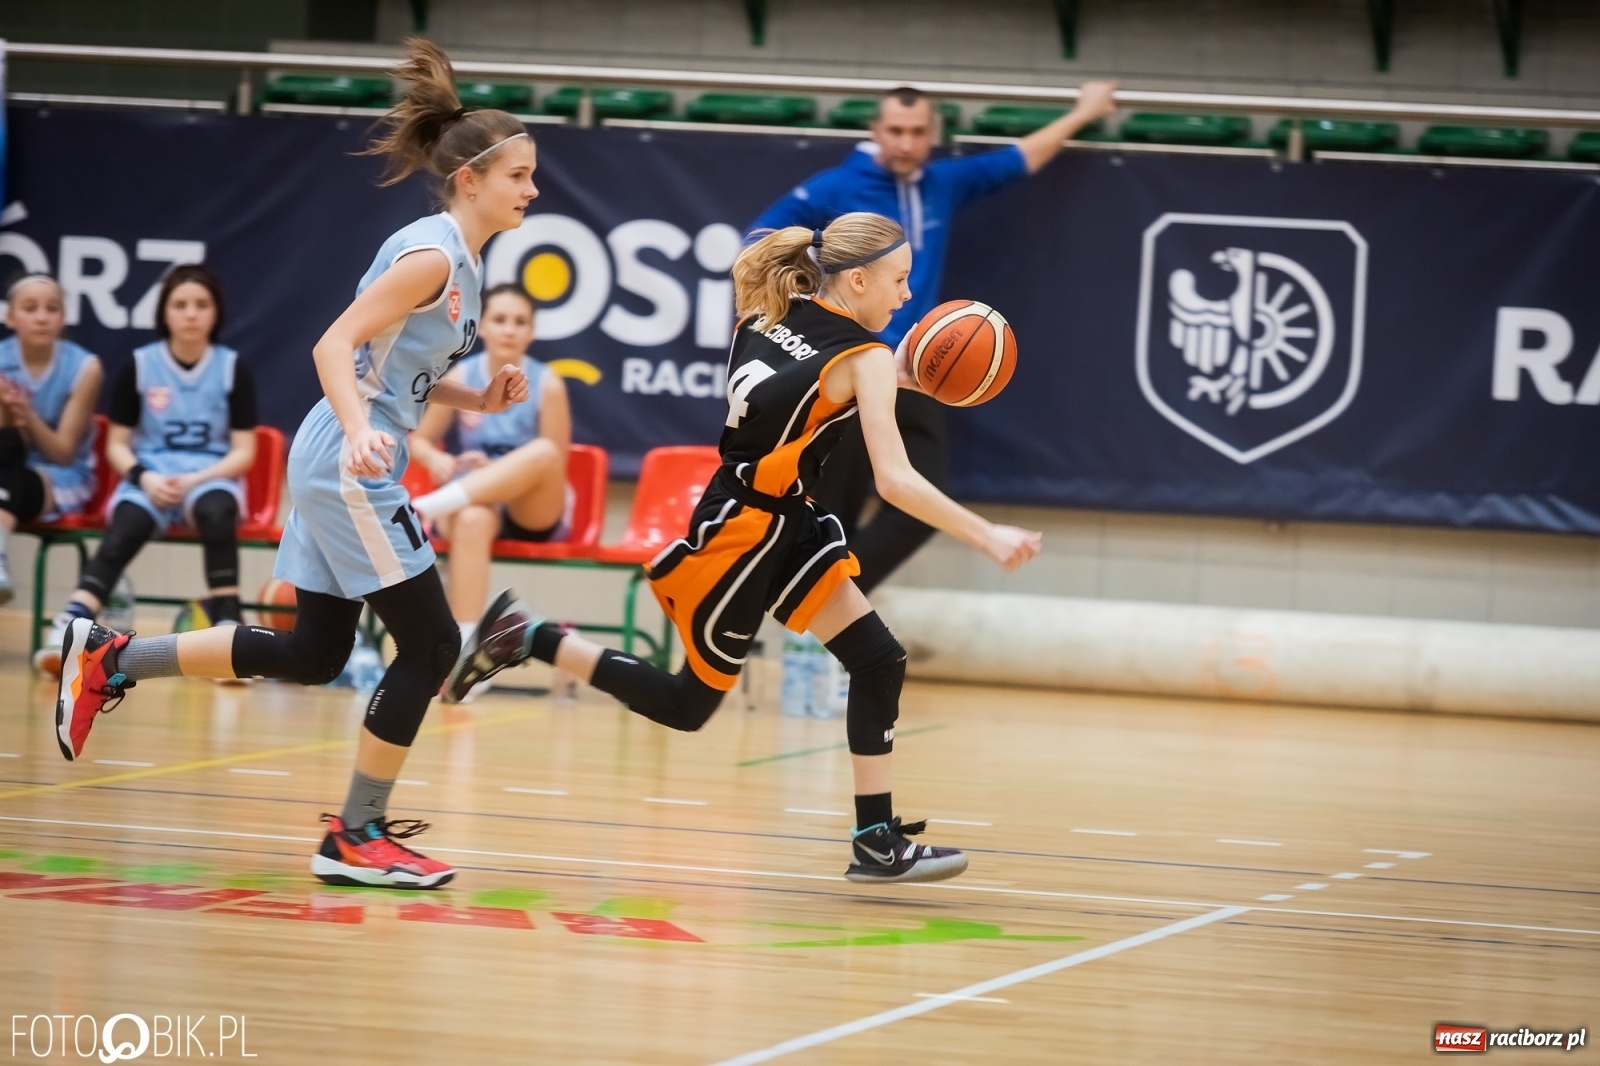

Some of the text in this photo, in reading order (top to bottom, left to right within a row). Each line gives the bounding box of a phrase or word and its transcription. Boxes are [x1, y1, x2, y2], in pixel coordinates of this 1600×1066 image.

[924, 328, 963, 382] molten
[1491, 306, 1600, 406] R
[164, 420, 211, 452] 23
